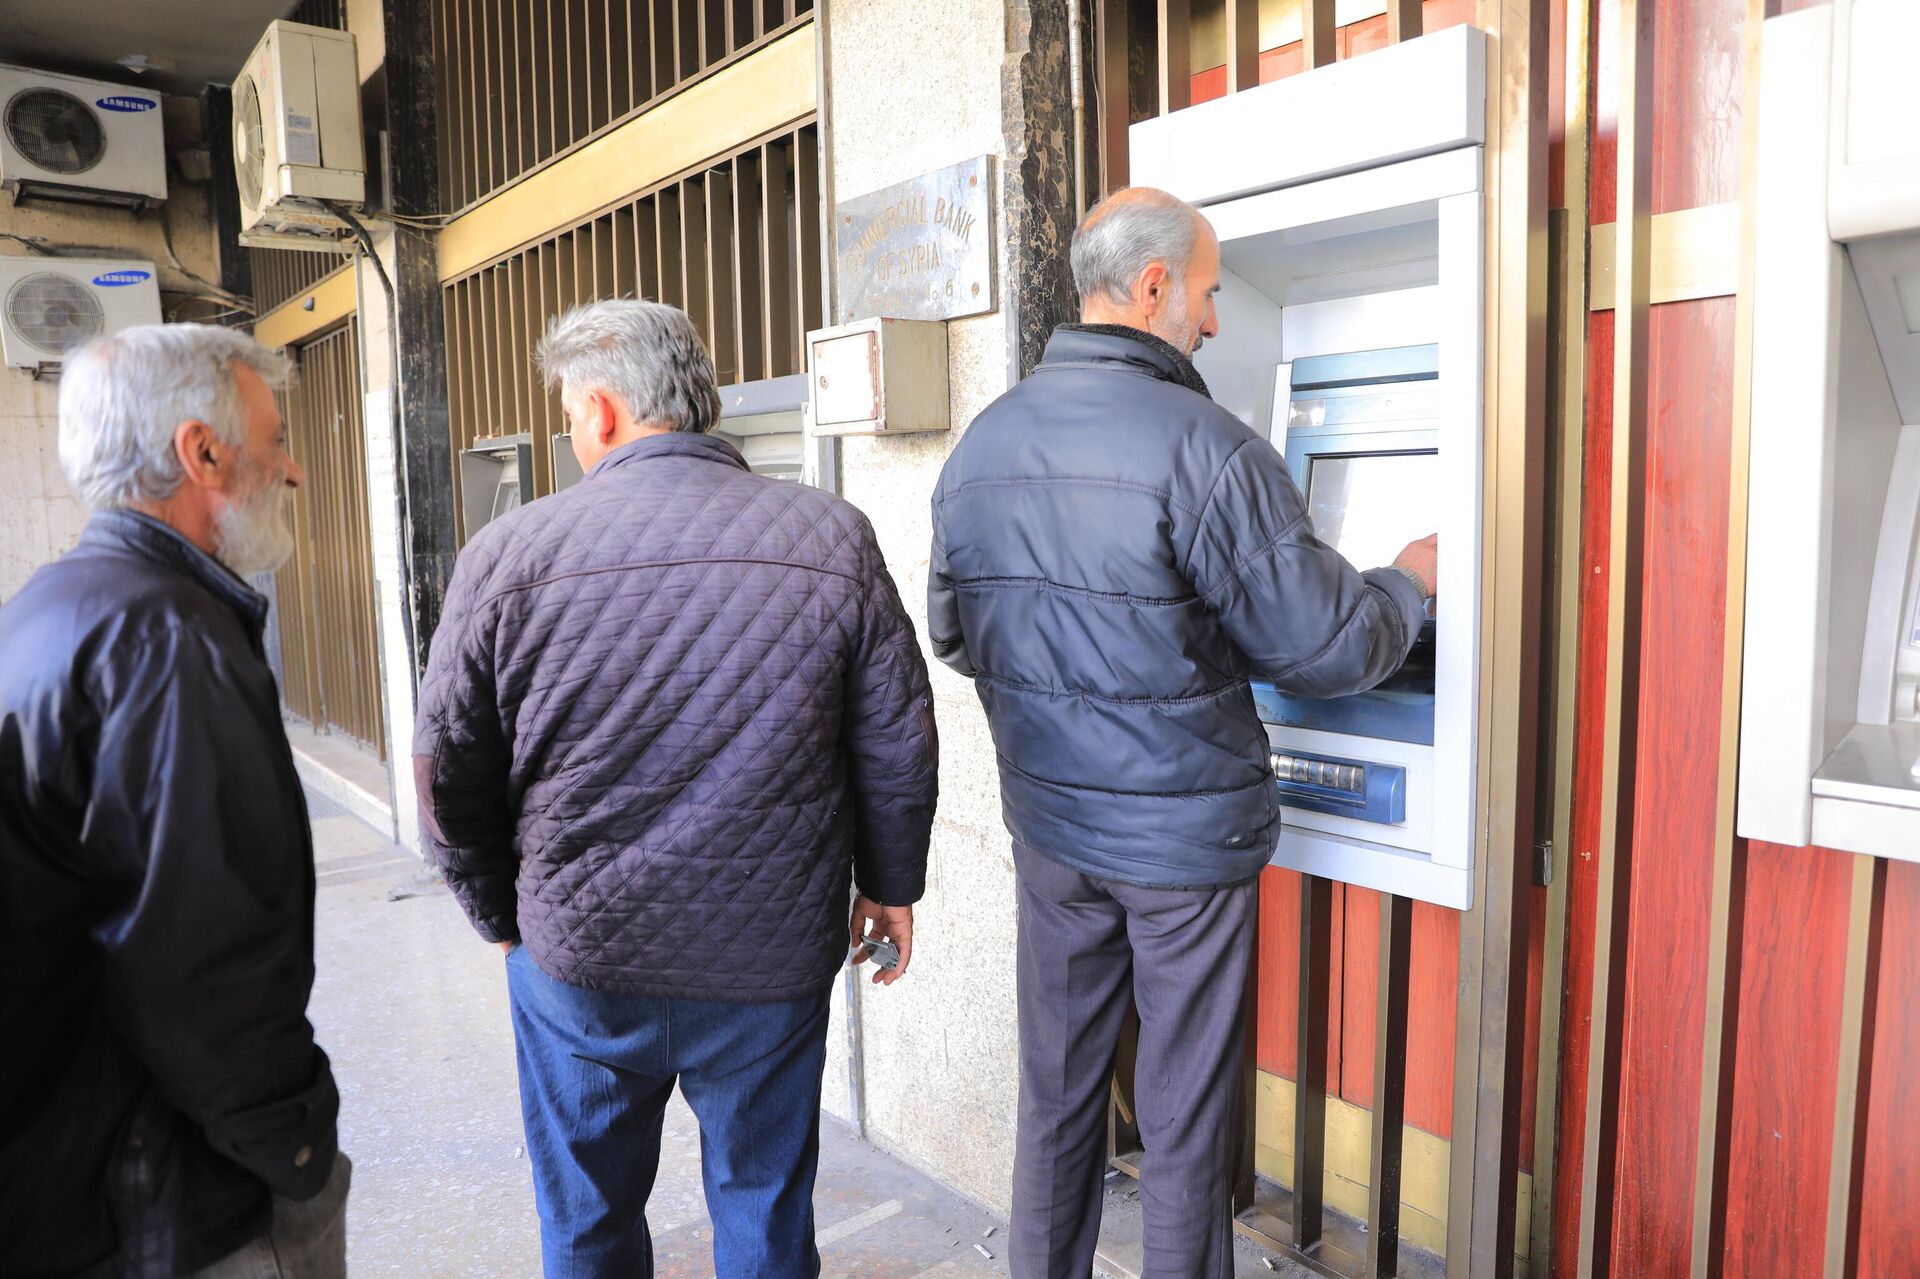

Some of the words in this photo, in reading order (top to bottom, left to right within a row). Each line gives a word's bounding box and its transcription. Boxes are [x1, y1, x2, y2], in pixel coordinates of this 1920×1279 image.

[102, 97, 150, 111] SAMSUNG
[846, 194, 929, 275] COMMERCIAL
[934, 197, 976, 244] BANK
[878, 252, 896, 281] OF
[899, 241, 940, 275] SYRIA
[97, 273, 146, 284] SAMSUNG
[945, 279, 954, 297] 6
